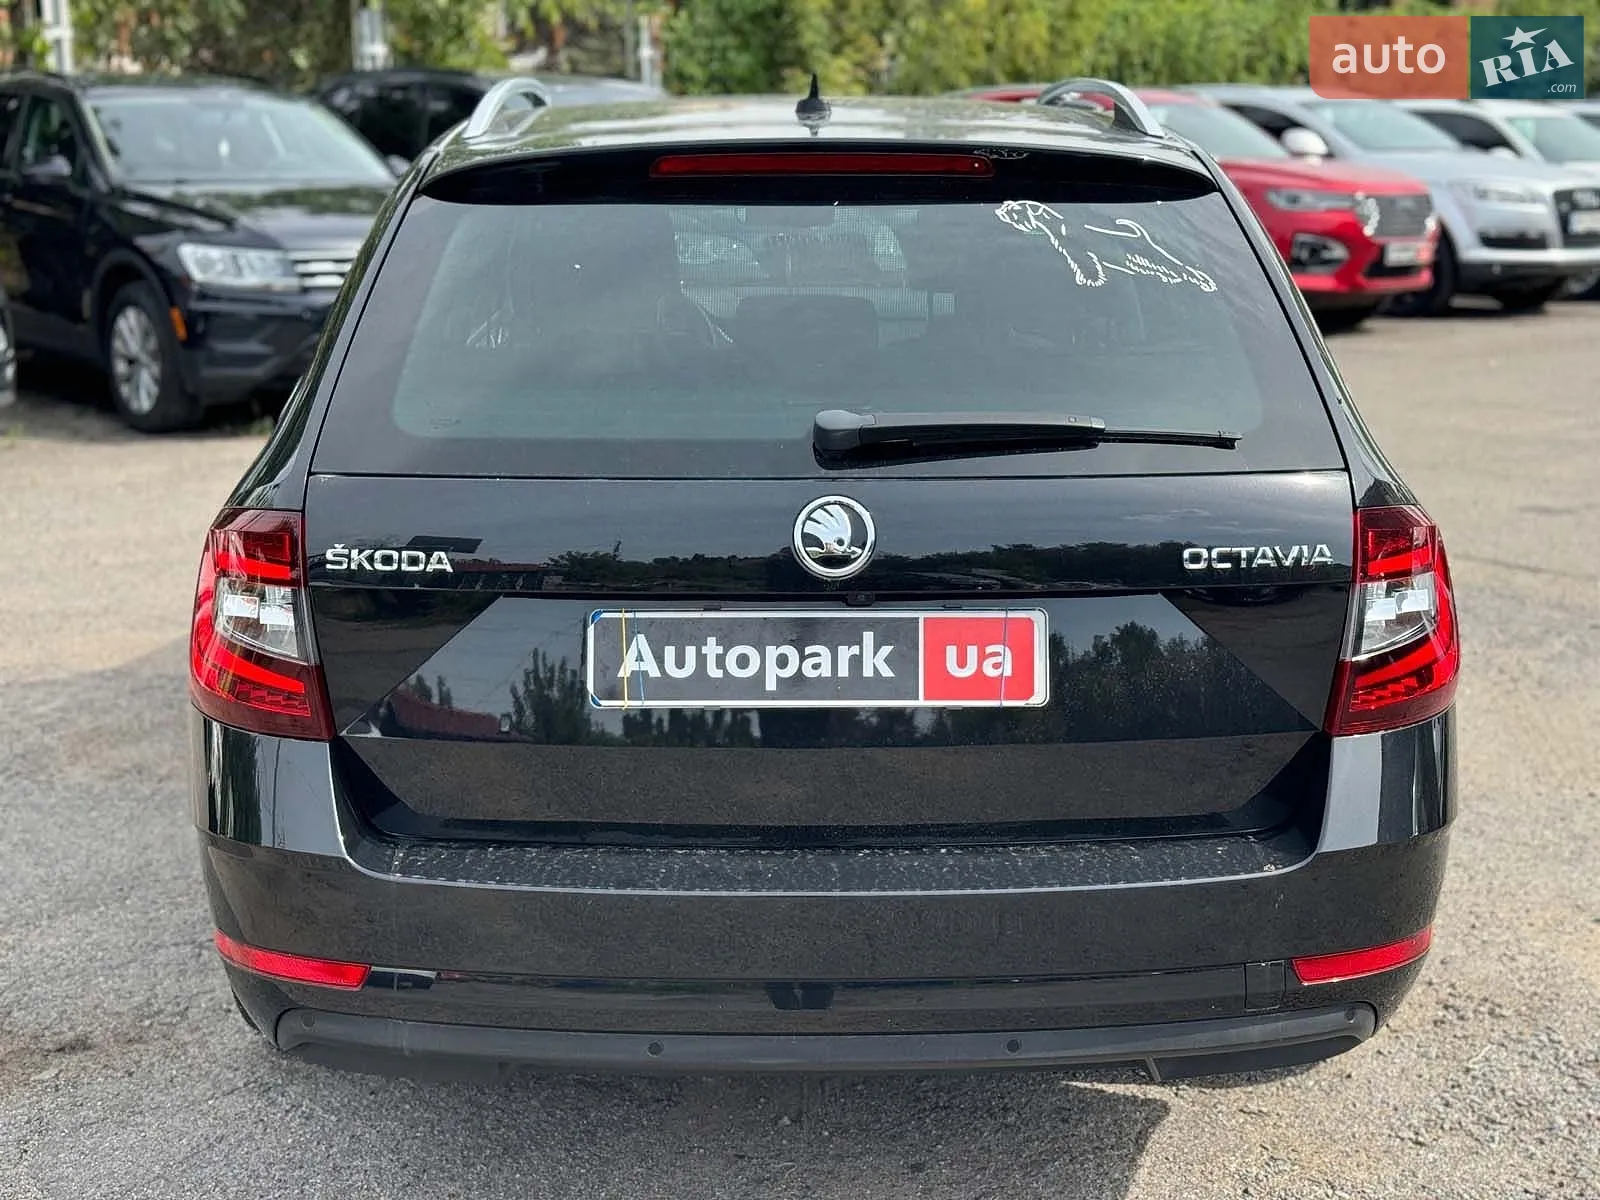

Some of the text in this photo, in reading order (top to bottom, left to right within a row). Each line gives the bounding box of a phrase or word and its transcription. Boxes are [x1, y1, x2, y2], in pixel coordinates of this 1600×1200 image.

[325, 543, 453, 573] ŠKODA
[1183, 544, 1334, 570] OCTAVIA
[617, 631, 1013, 691] Autopark ua
